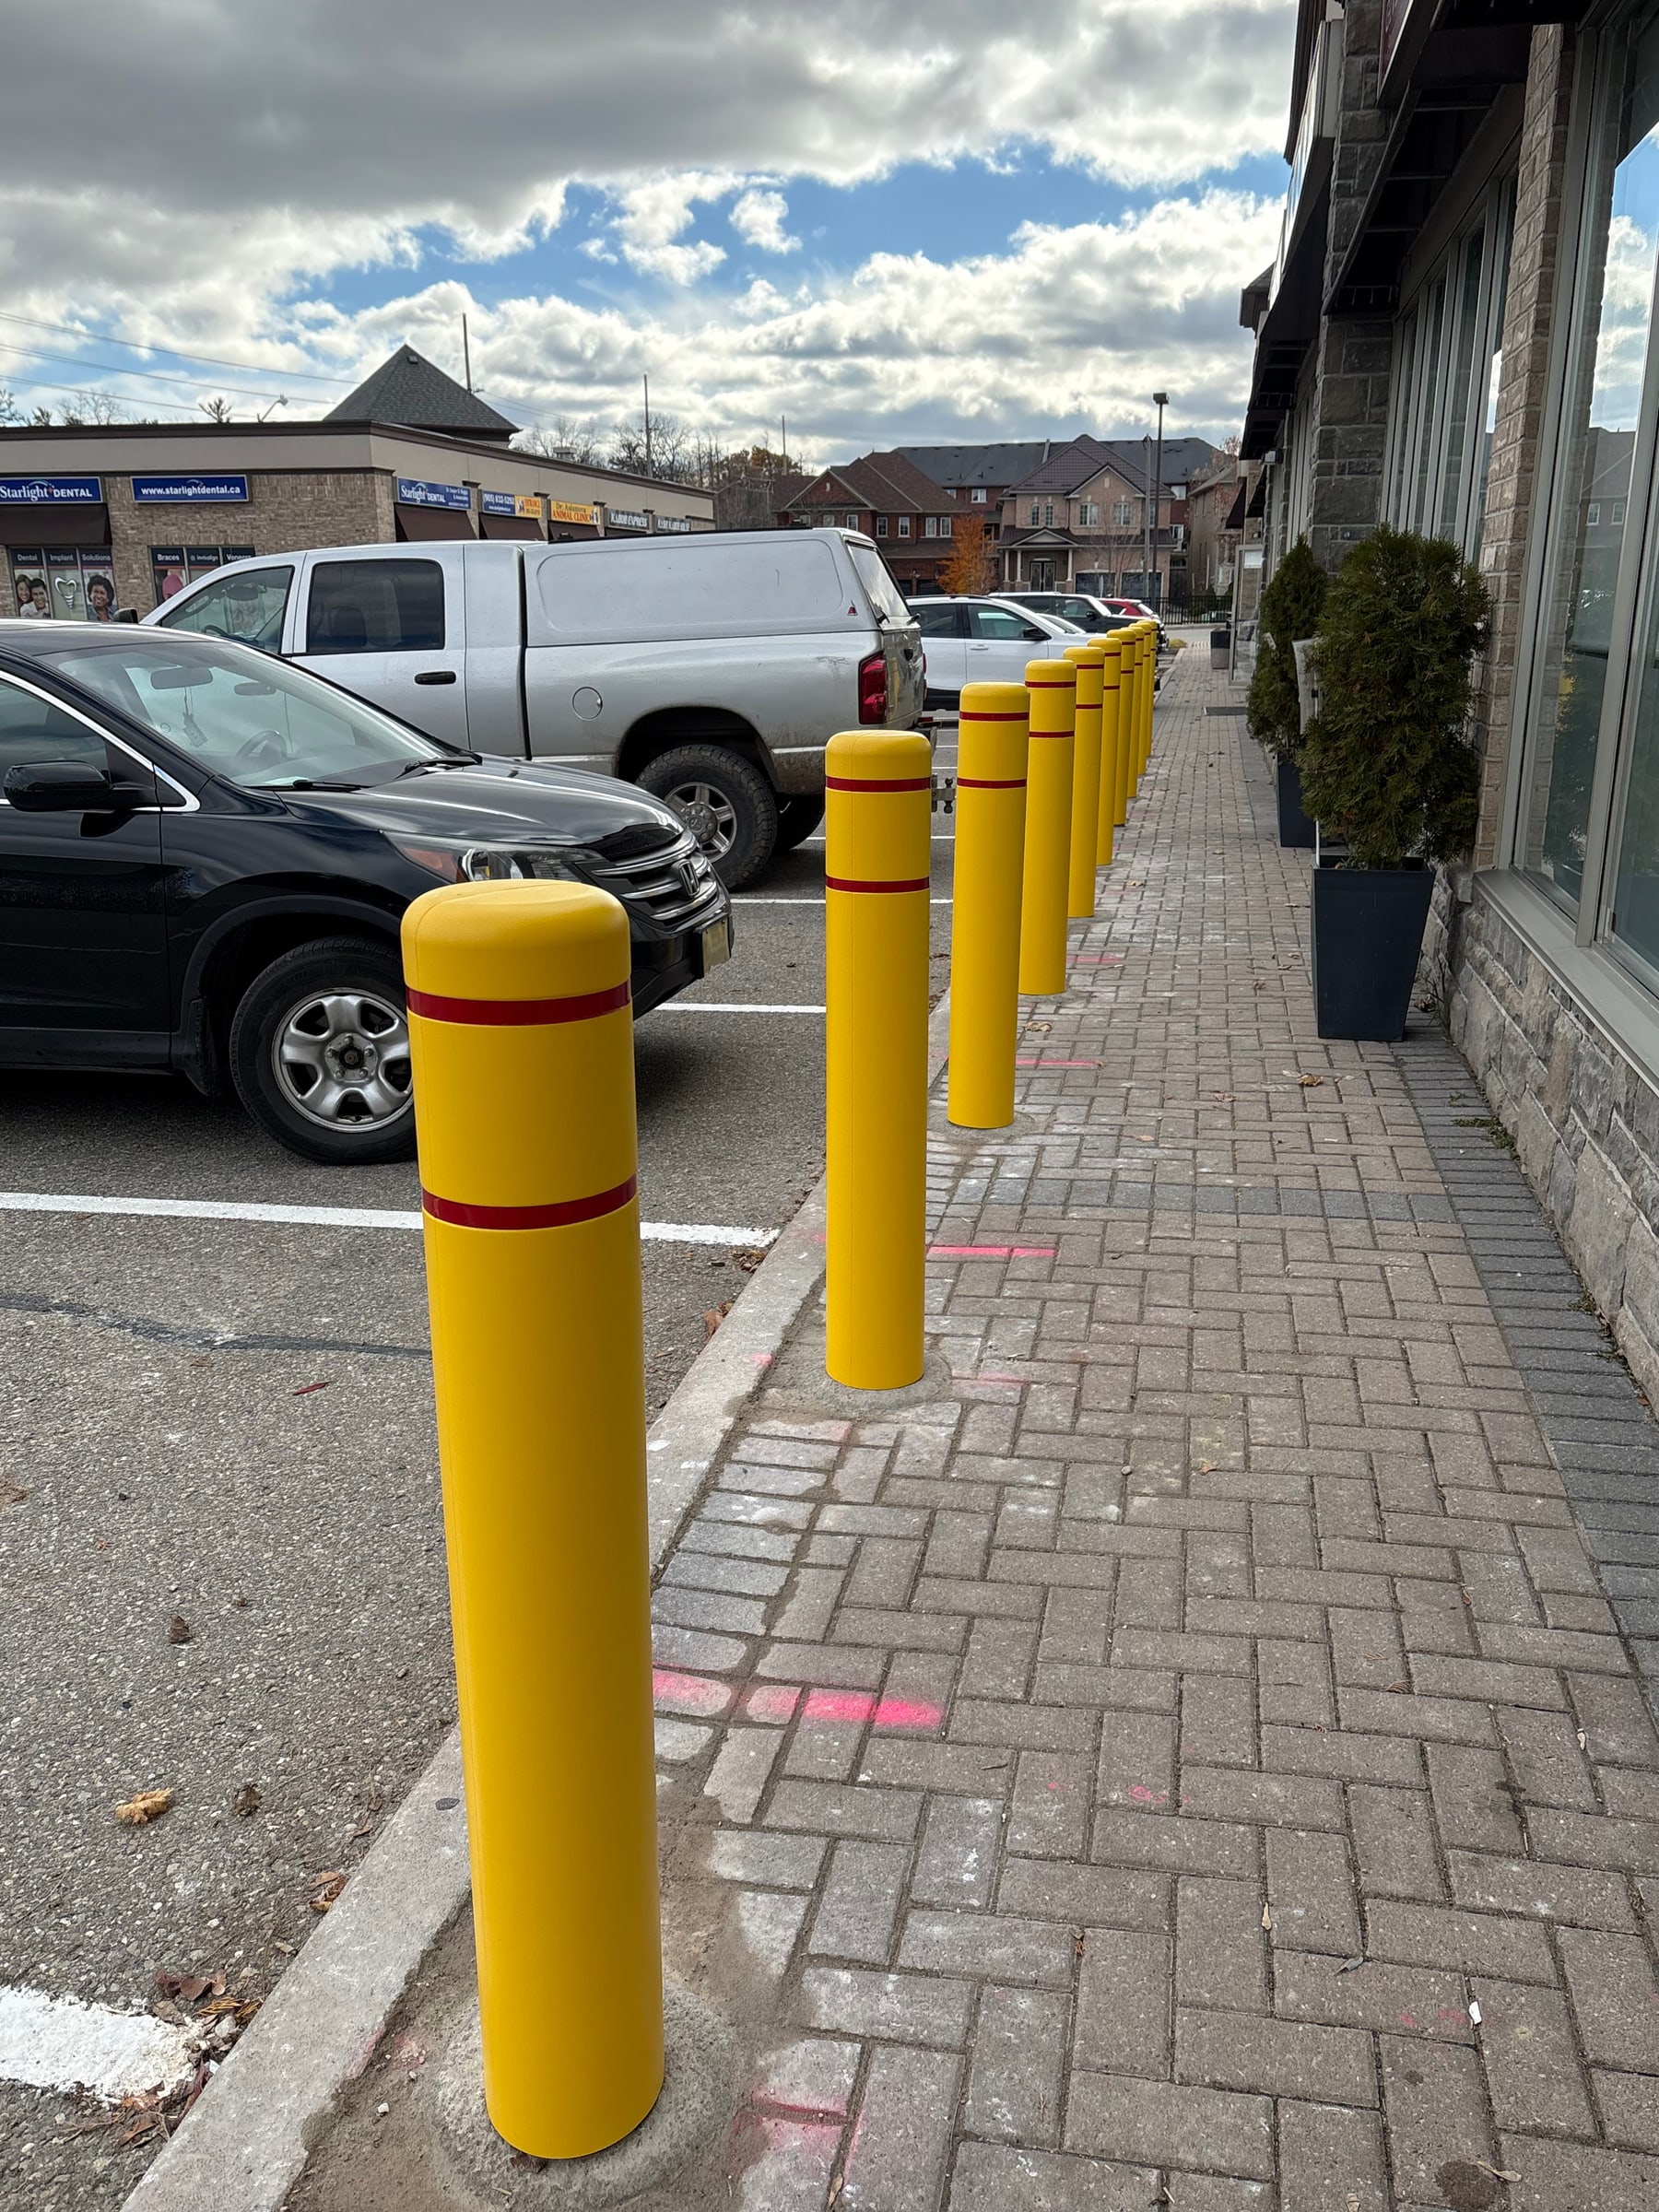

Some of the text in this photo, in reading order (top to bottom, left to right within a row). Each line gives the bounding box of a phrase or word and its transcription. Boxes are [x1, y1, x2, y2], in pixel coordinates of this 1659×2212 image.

[0, 485, 93, 501] Starlight DENTAL
[141, 485, 241, 496] www.starlightdental.ca
[400, 485, 426, 503] Starlight
[427, 493, 446, 503] DENTAL
[553, 510, 573, 521] ANIMAL
[574, 512, 592, 523] CLINIC
[628, 515, 648, 527] EXPRESS
[50, 554, 74, 562] Implant
